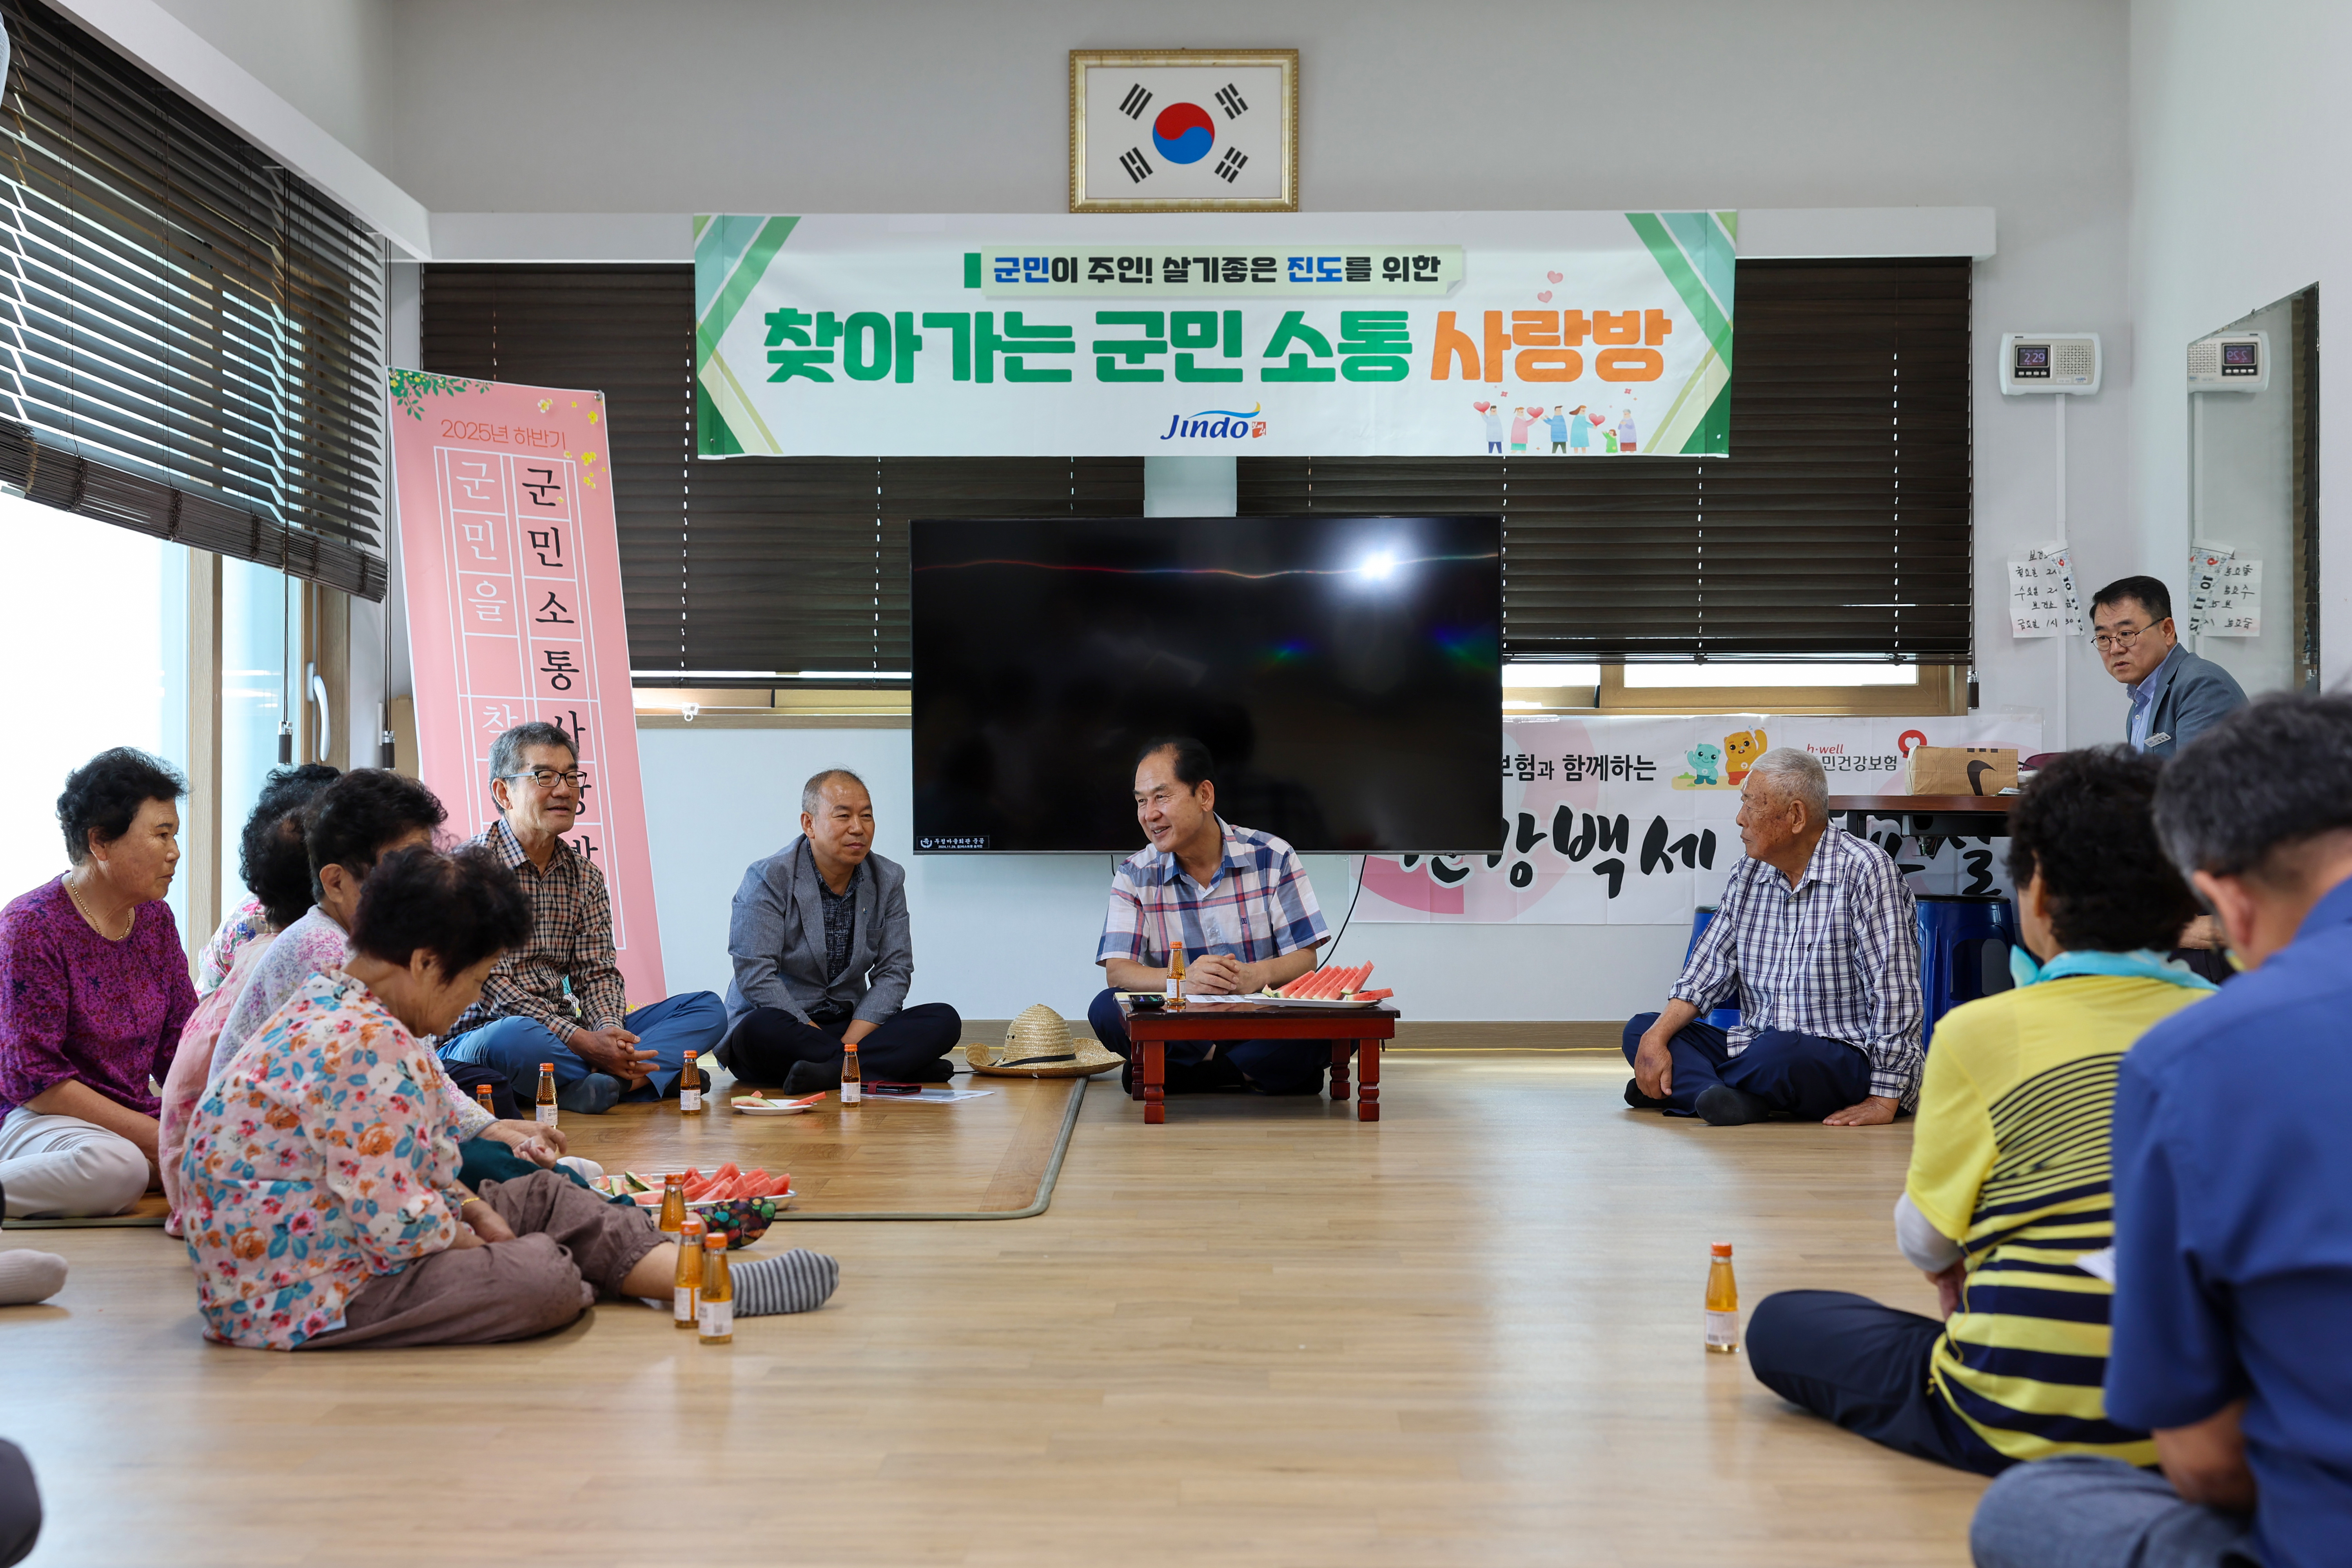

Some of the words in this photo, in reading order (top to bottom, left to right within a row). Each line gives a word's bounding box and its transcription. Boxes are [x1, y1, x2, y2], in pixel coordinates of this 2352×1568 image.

[994, 257, 1078, 283] 군민이
[1088, 256, 1152, 284] 주인!
[1162, 256, 1277, 283] 살기좋은
[1287, 256, 1372, 283] 진도를
[1382, 255, 1441, 282] 위한
[764, 307, 1075, 383] 찾아가는
[1093, 310, 1243, 383] 군민
[1261, 310, 1413, 383] 소통
[1430, 309, 1672, 383] 사랑방
[441, 419, 509, 444] 2025년
[513, 426, 566, 450] 하반기
[1160, 414, 1249, 440] Jindo
[2017, 619, 2040, 631] 금요일
[1563, 754, 1657, 782] 함께하는
[1820, 755, 1897, 772] 민건강보험
